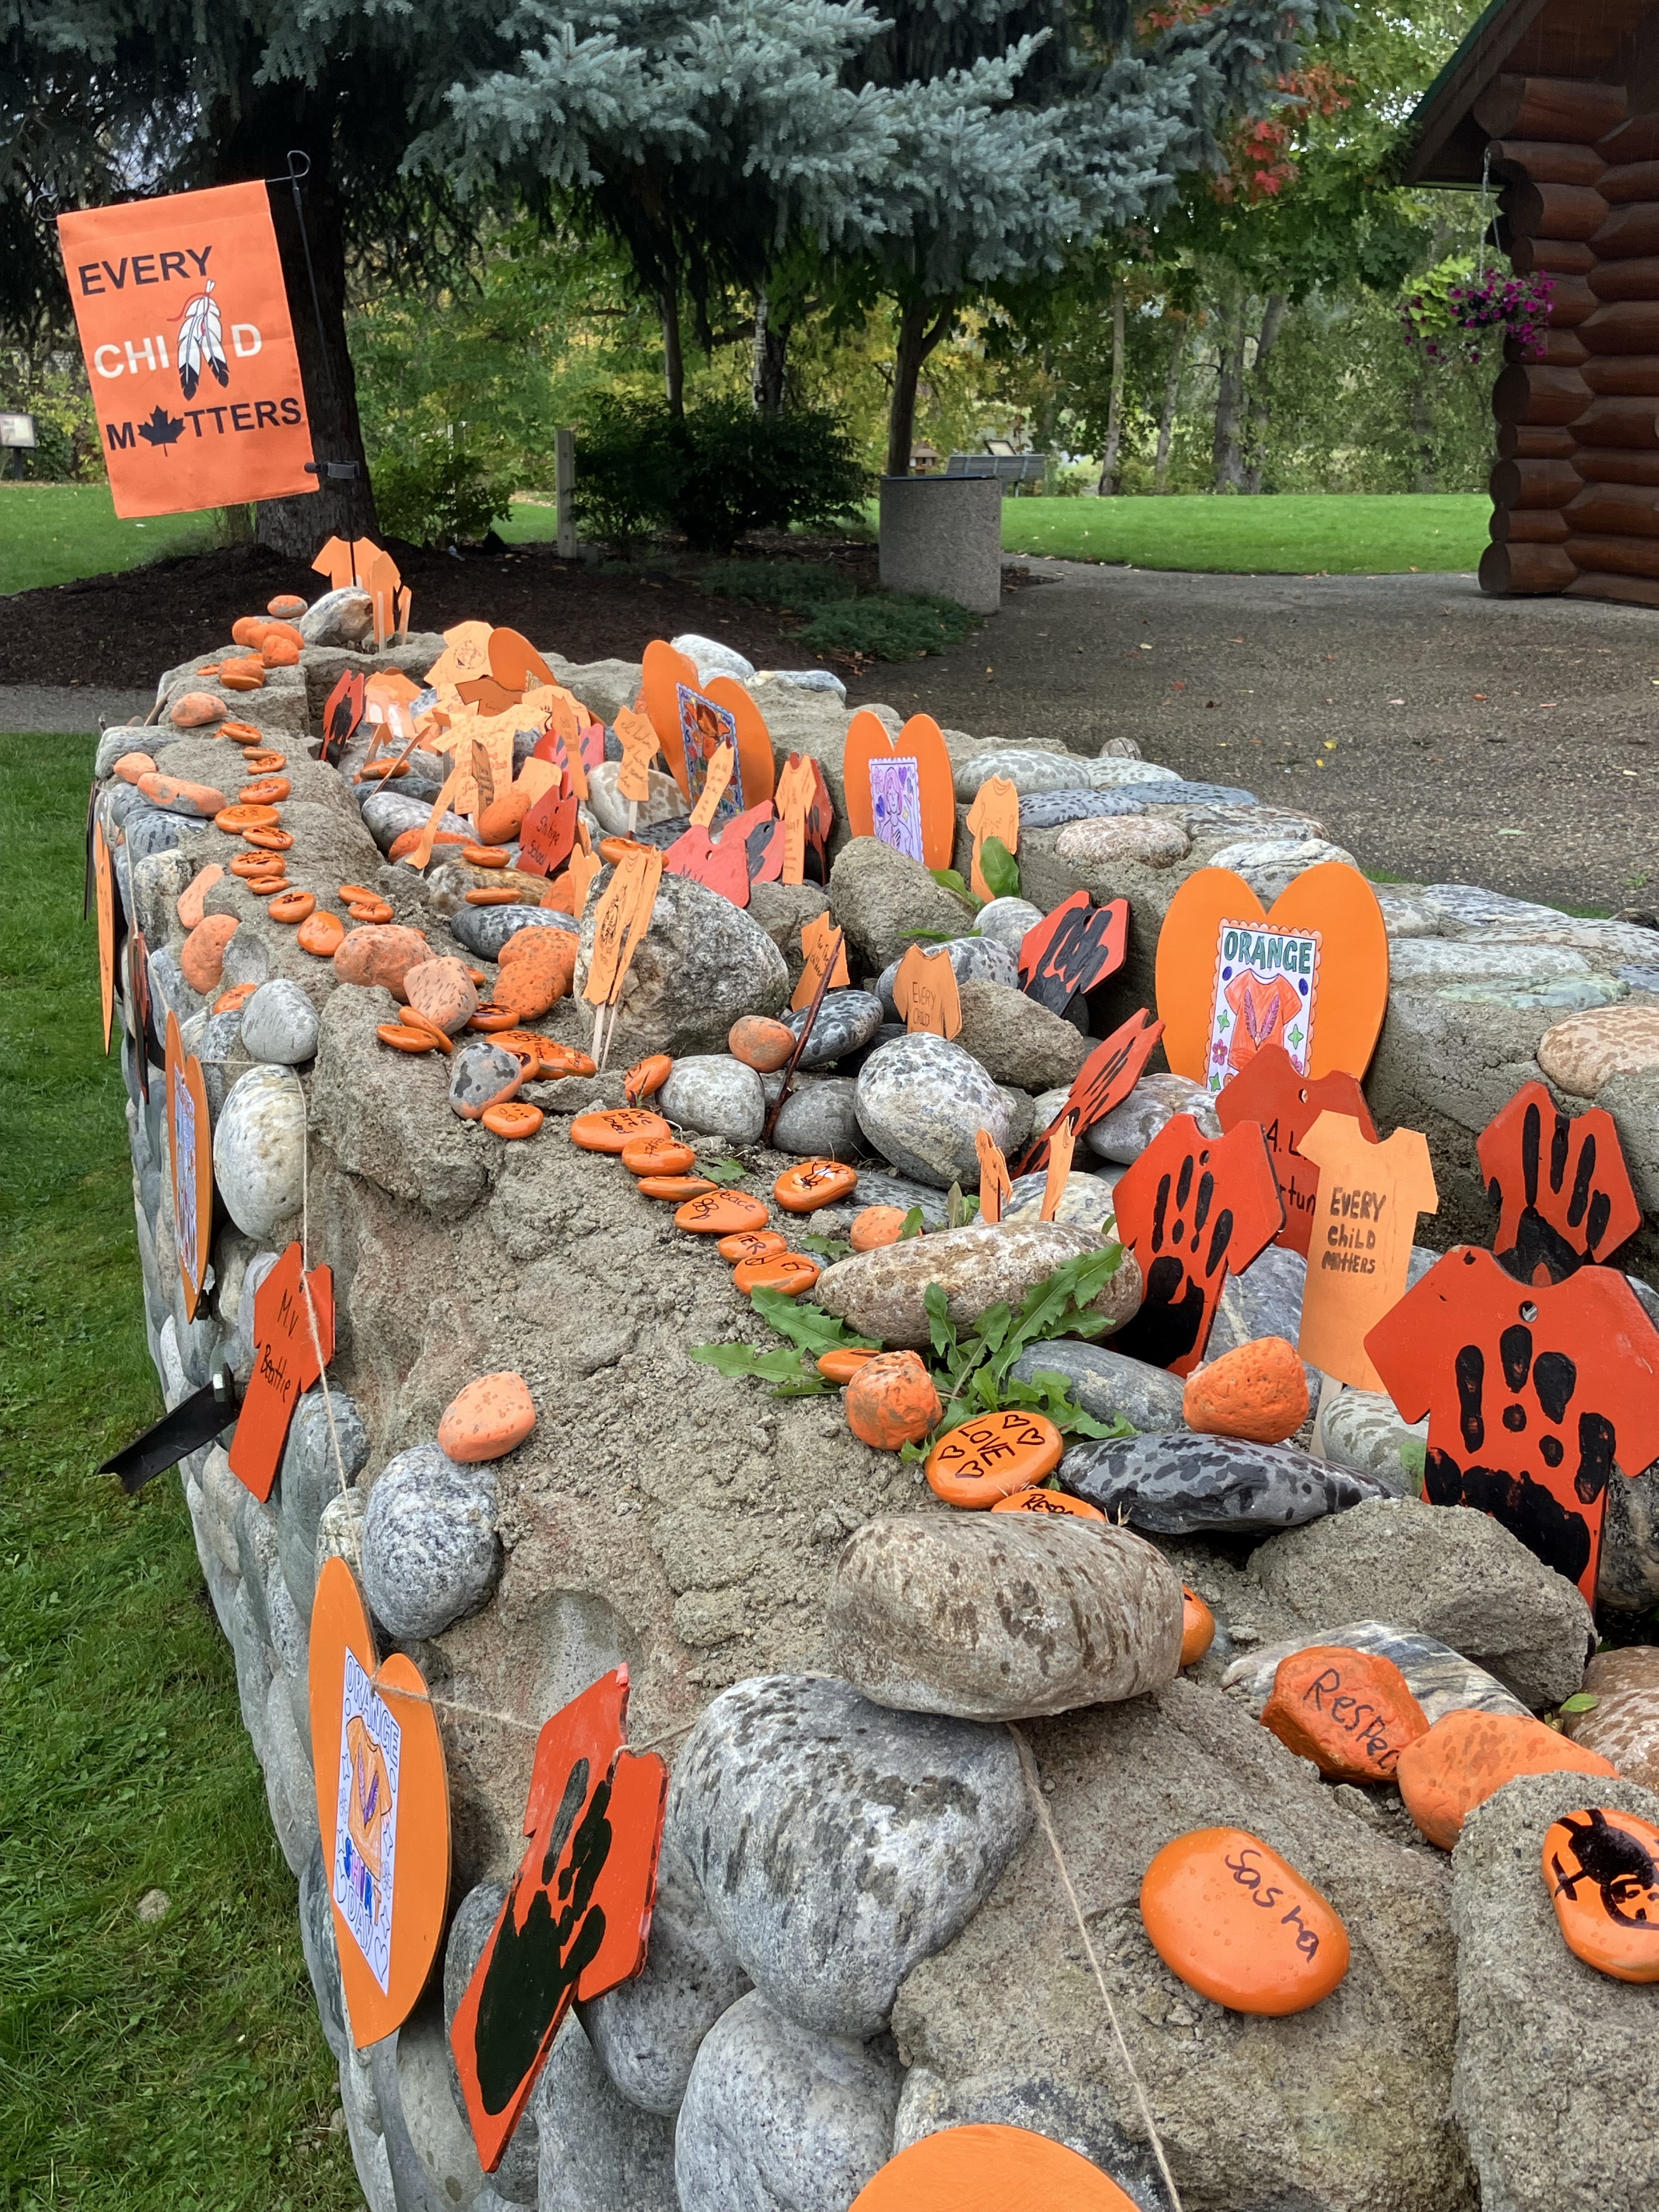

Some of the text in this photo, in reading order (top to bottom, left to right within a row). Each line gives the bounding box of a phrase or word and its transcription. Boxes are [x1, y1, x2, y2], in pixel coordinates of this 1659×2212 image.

[78, 246, 213, 296] EVERY
[93, 323, 262, 379] CHID
[106, 398, 301, 451] MTTERS
[527, 839, 548, 866] School
[1223, 931, 1312, 974] ORANGE
[912, 981, 936, 1011] EVERY
[1329, 1187, 1387, 1223] EVERY
[958, 1418, 1016, 1466] LOVE
[346, 1654, 399, 1768] ORANGE
[343, 1836, 382, 1927] SHIRT
[1224, 1849, 1320, 1963] Sasha
[347, 1884, 374, 1956] DAY
